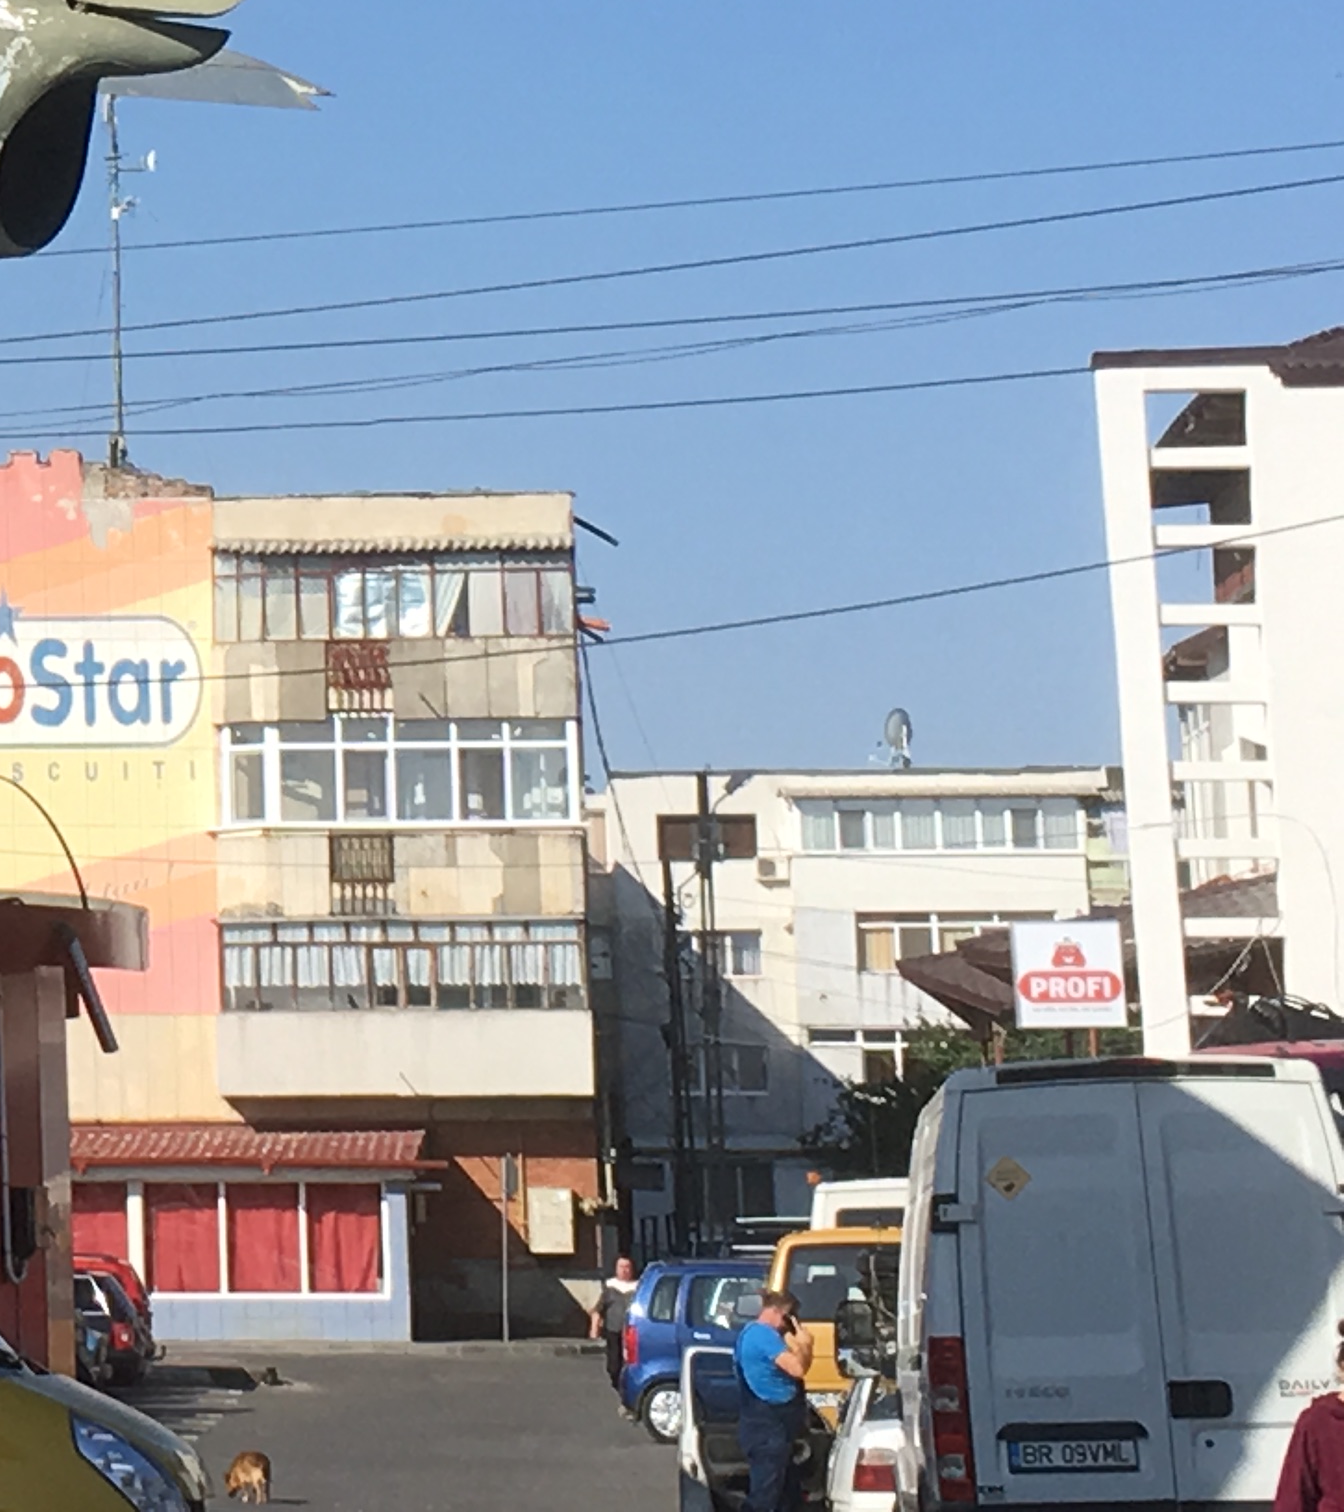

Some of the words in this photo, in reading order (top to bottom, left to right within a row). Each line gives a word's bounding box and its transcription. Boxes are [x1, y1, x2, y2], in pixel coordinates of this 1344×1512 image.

[1029, 975, 1113, 1000] PROFI
[1278, 1379, 1330, 1390] DAILY
[1022, 1444, 1054, 1465] BR
